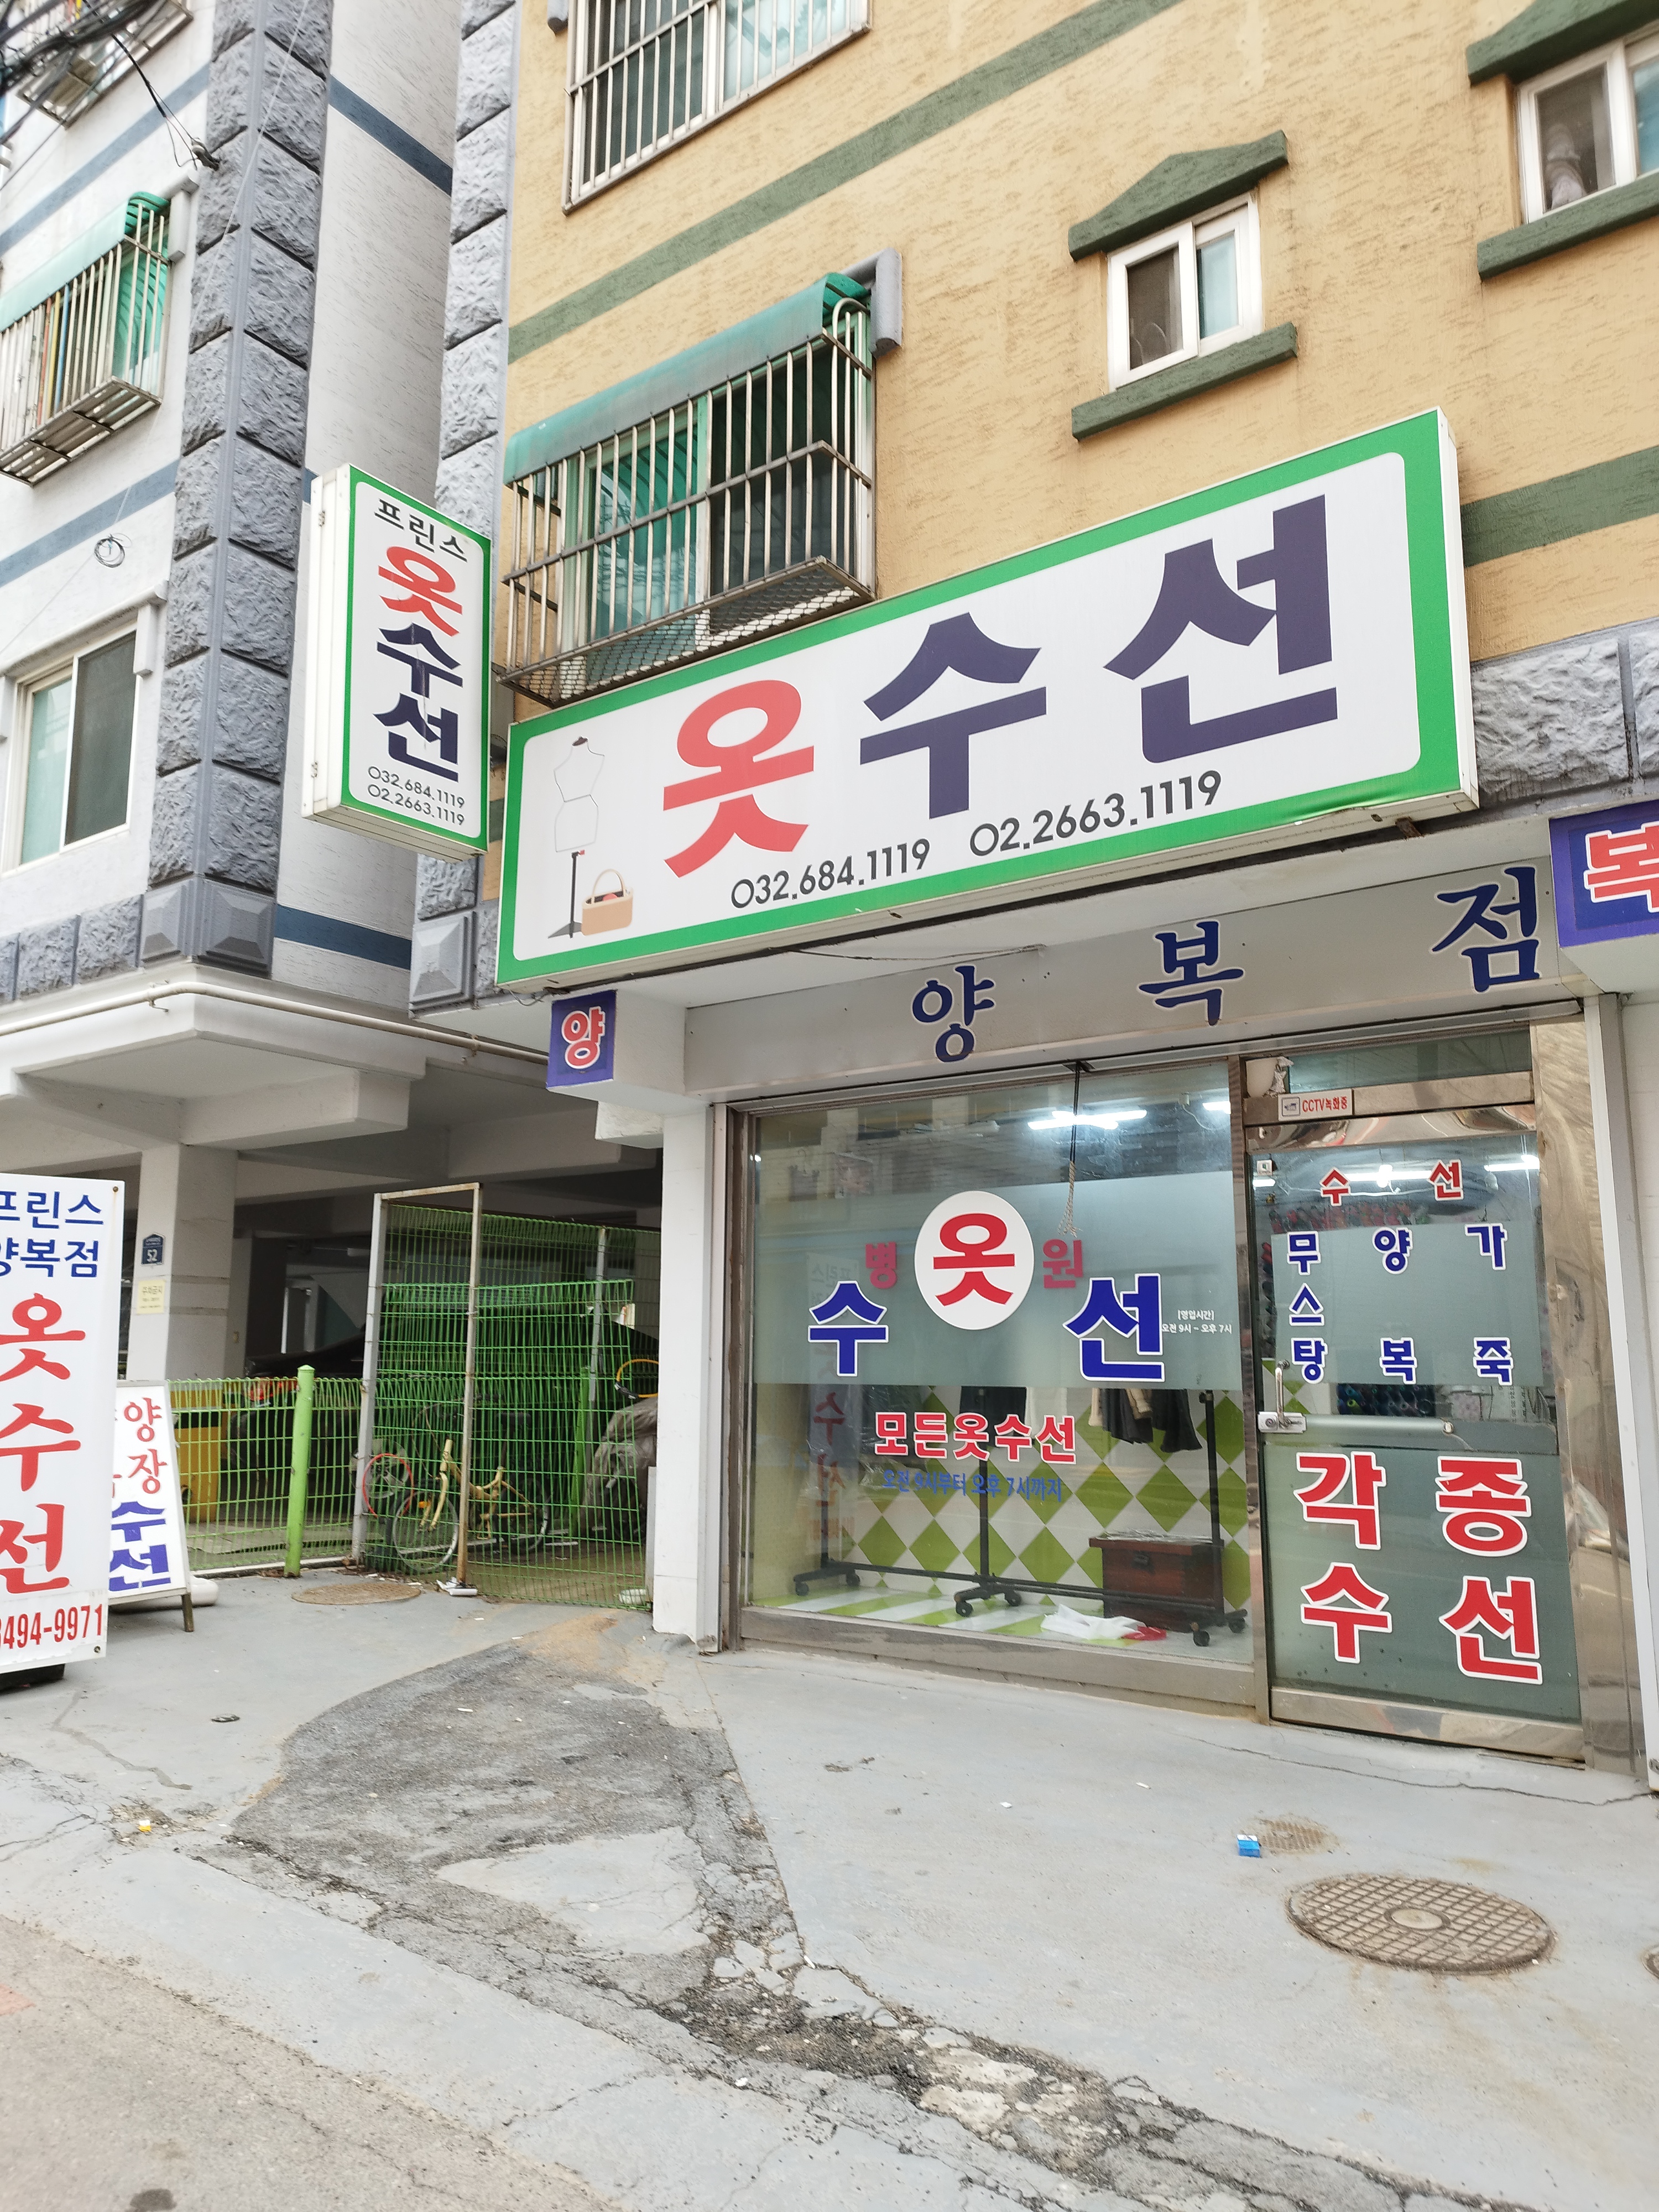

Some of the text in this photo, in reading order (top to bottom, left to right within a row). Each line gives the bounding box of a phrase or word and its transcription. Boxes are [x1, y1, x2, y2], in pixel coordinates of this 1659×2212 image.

[374, 498, 467, 562] 프린스
[372, 546, 463, 782] 옷수선
[663, 495, 1338, 878] 옷수선
[368, 766, 465, 808] 032.684.1119
[368, 784, 465, 826] 02.2663.1119
[731, 770, 1222, 909] 032.684.1119 02.2663.1119
[561, 1006, 606, 1069] 양
[147, 1248, 158, 1262] 52
[1162, 1322, 1177, 1334] 오전
[1178, 1323, 1191, 1334] 9시
[1201, 1323, 1217, 1334] 오후
[1218, 1323, 1232, 1334] 7시
[882, 1469, 1062, 1503] 오전 9시부터 오후 7시까지
[0, 1604, 102, 1650] 494-9971
